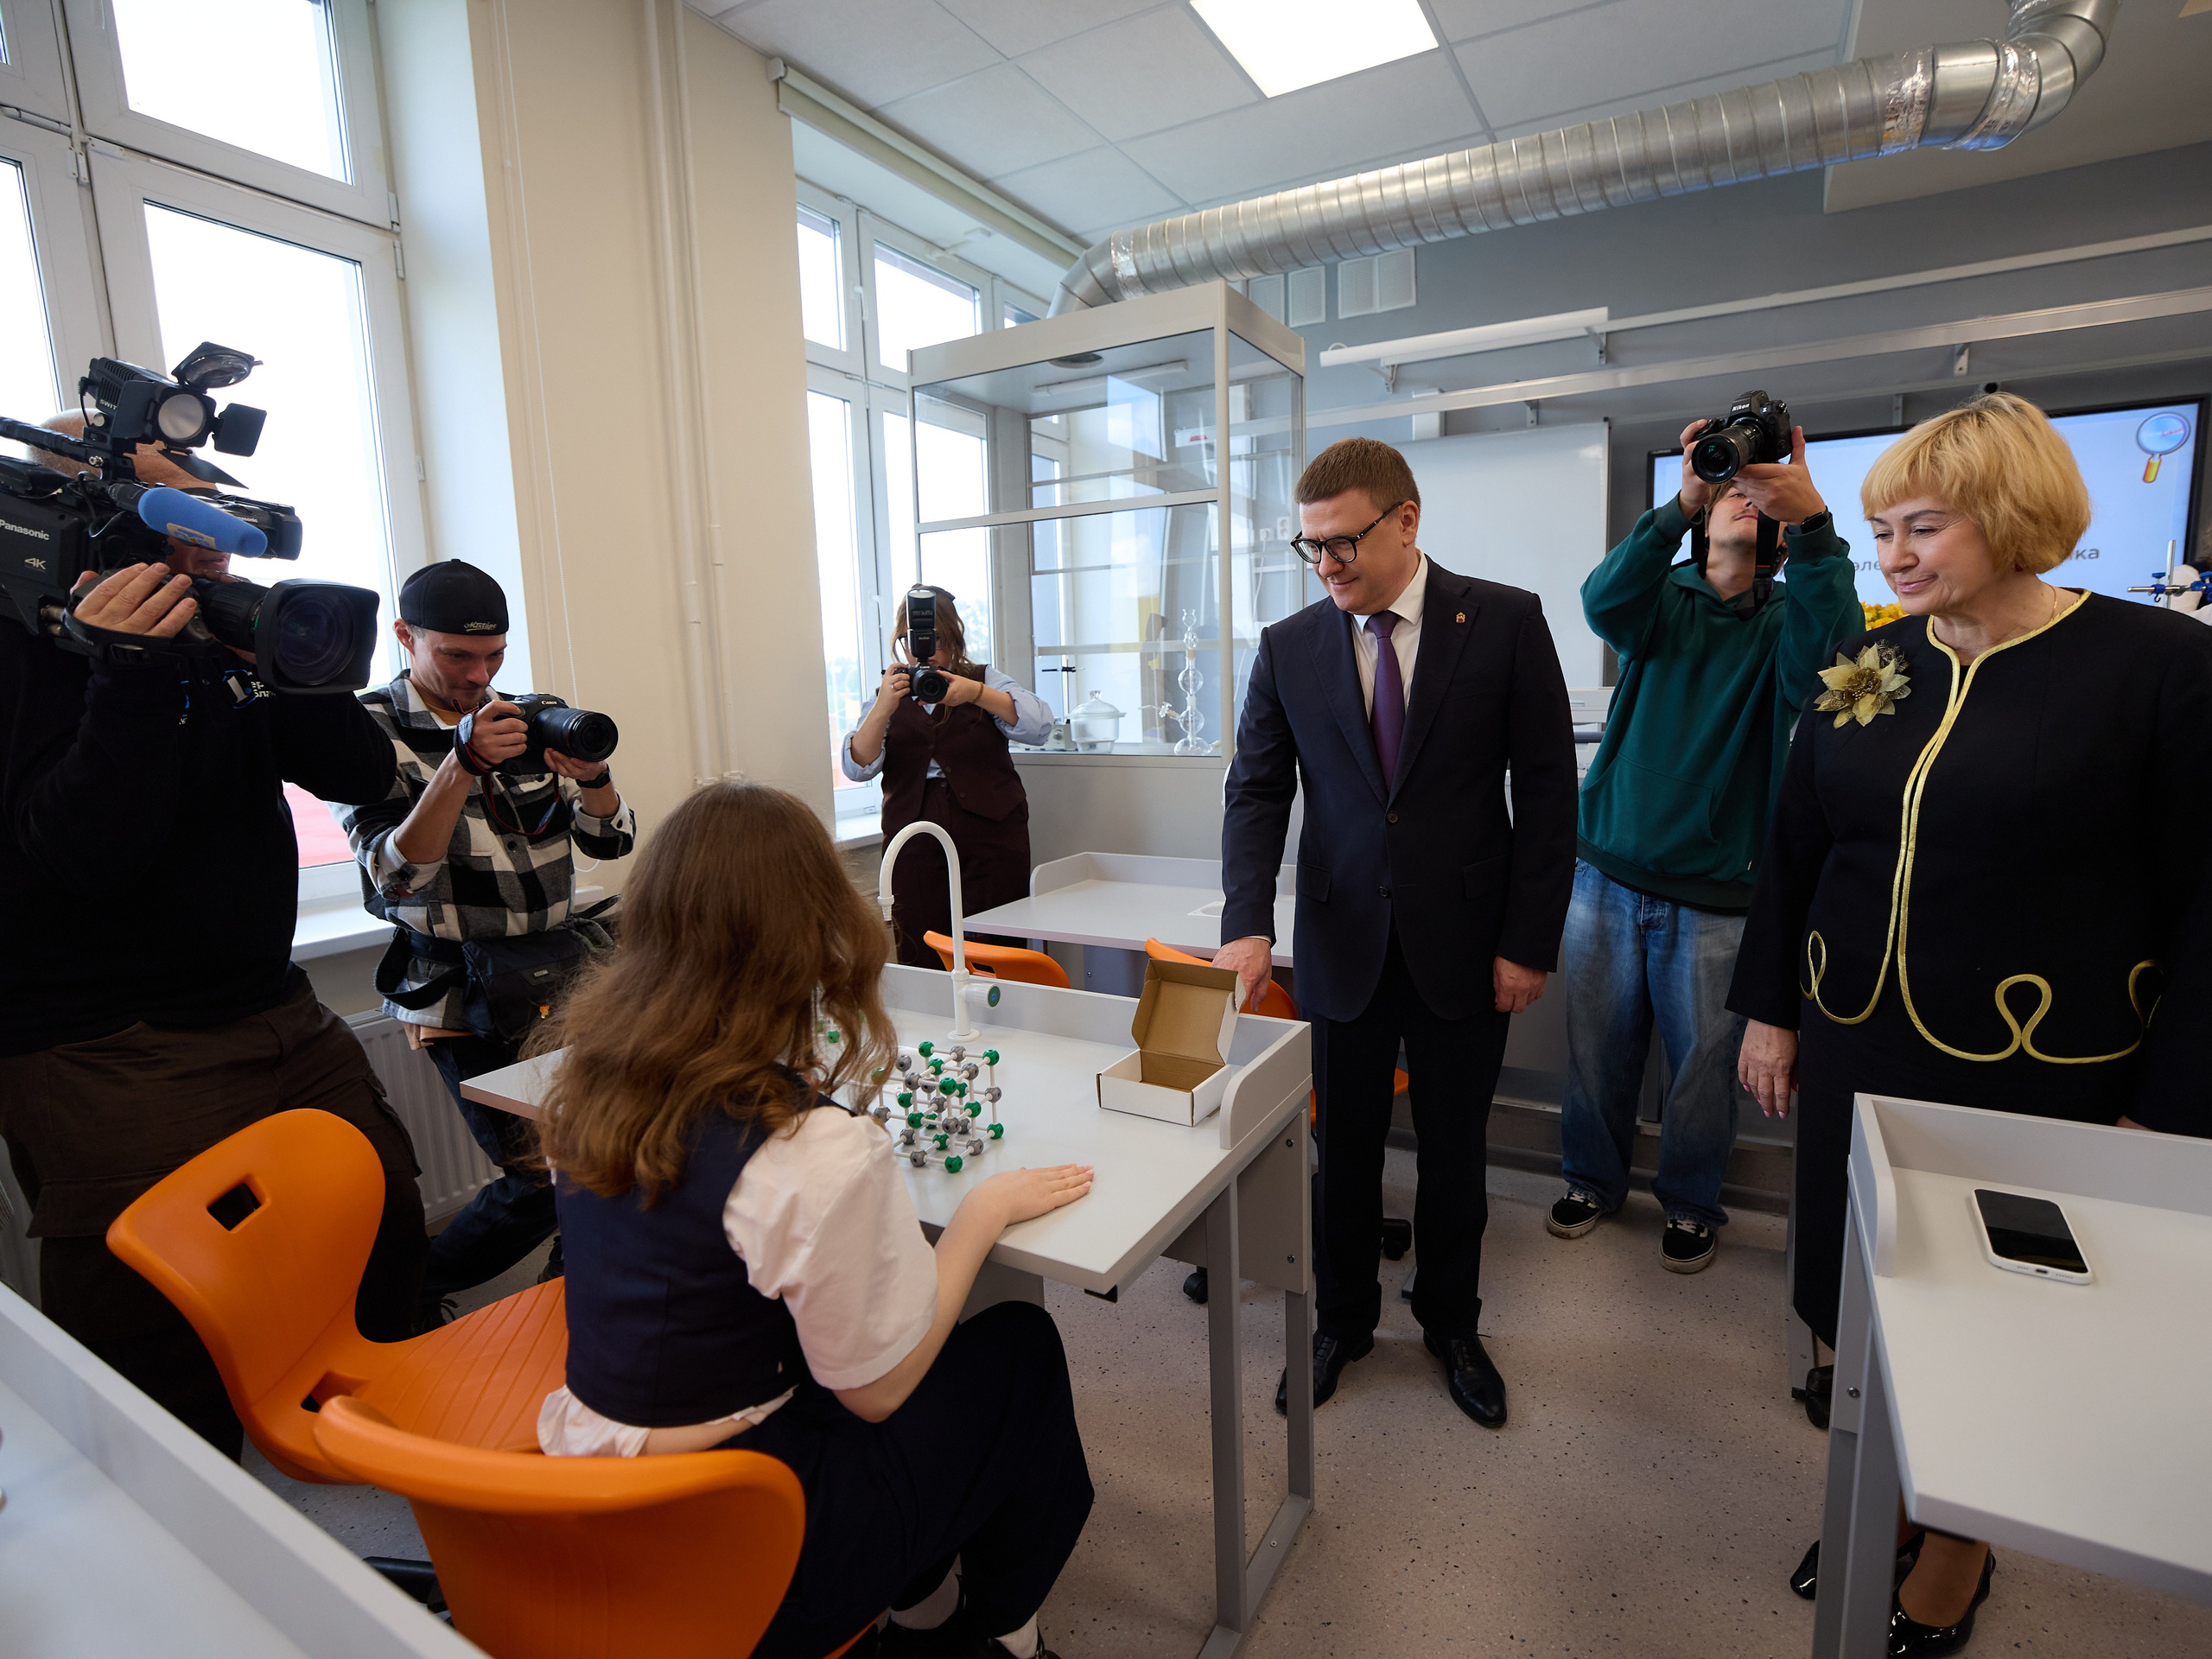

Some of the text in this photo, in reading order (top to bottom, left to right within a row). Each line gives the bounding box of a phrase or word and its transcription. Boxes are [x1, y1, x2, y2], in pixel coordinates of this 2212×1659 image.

[99, 398, 118, 410] SWIT
[1732, 403, 1750, 412] Nikon
[0, 519, 49, 540] Panasonic
[24, 557, 47, 570] 4K
